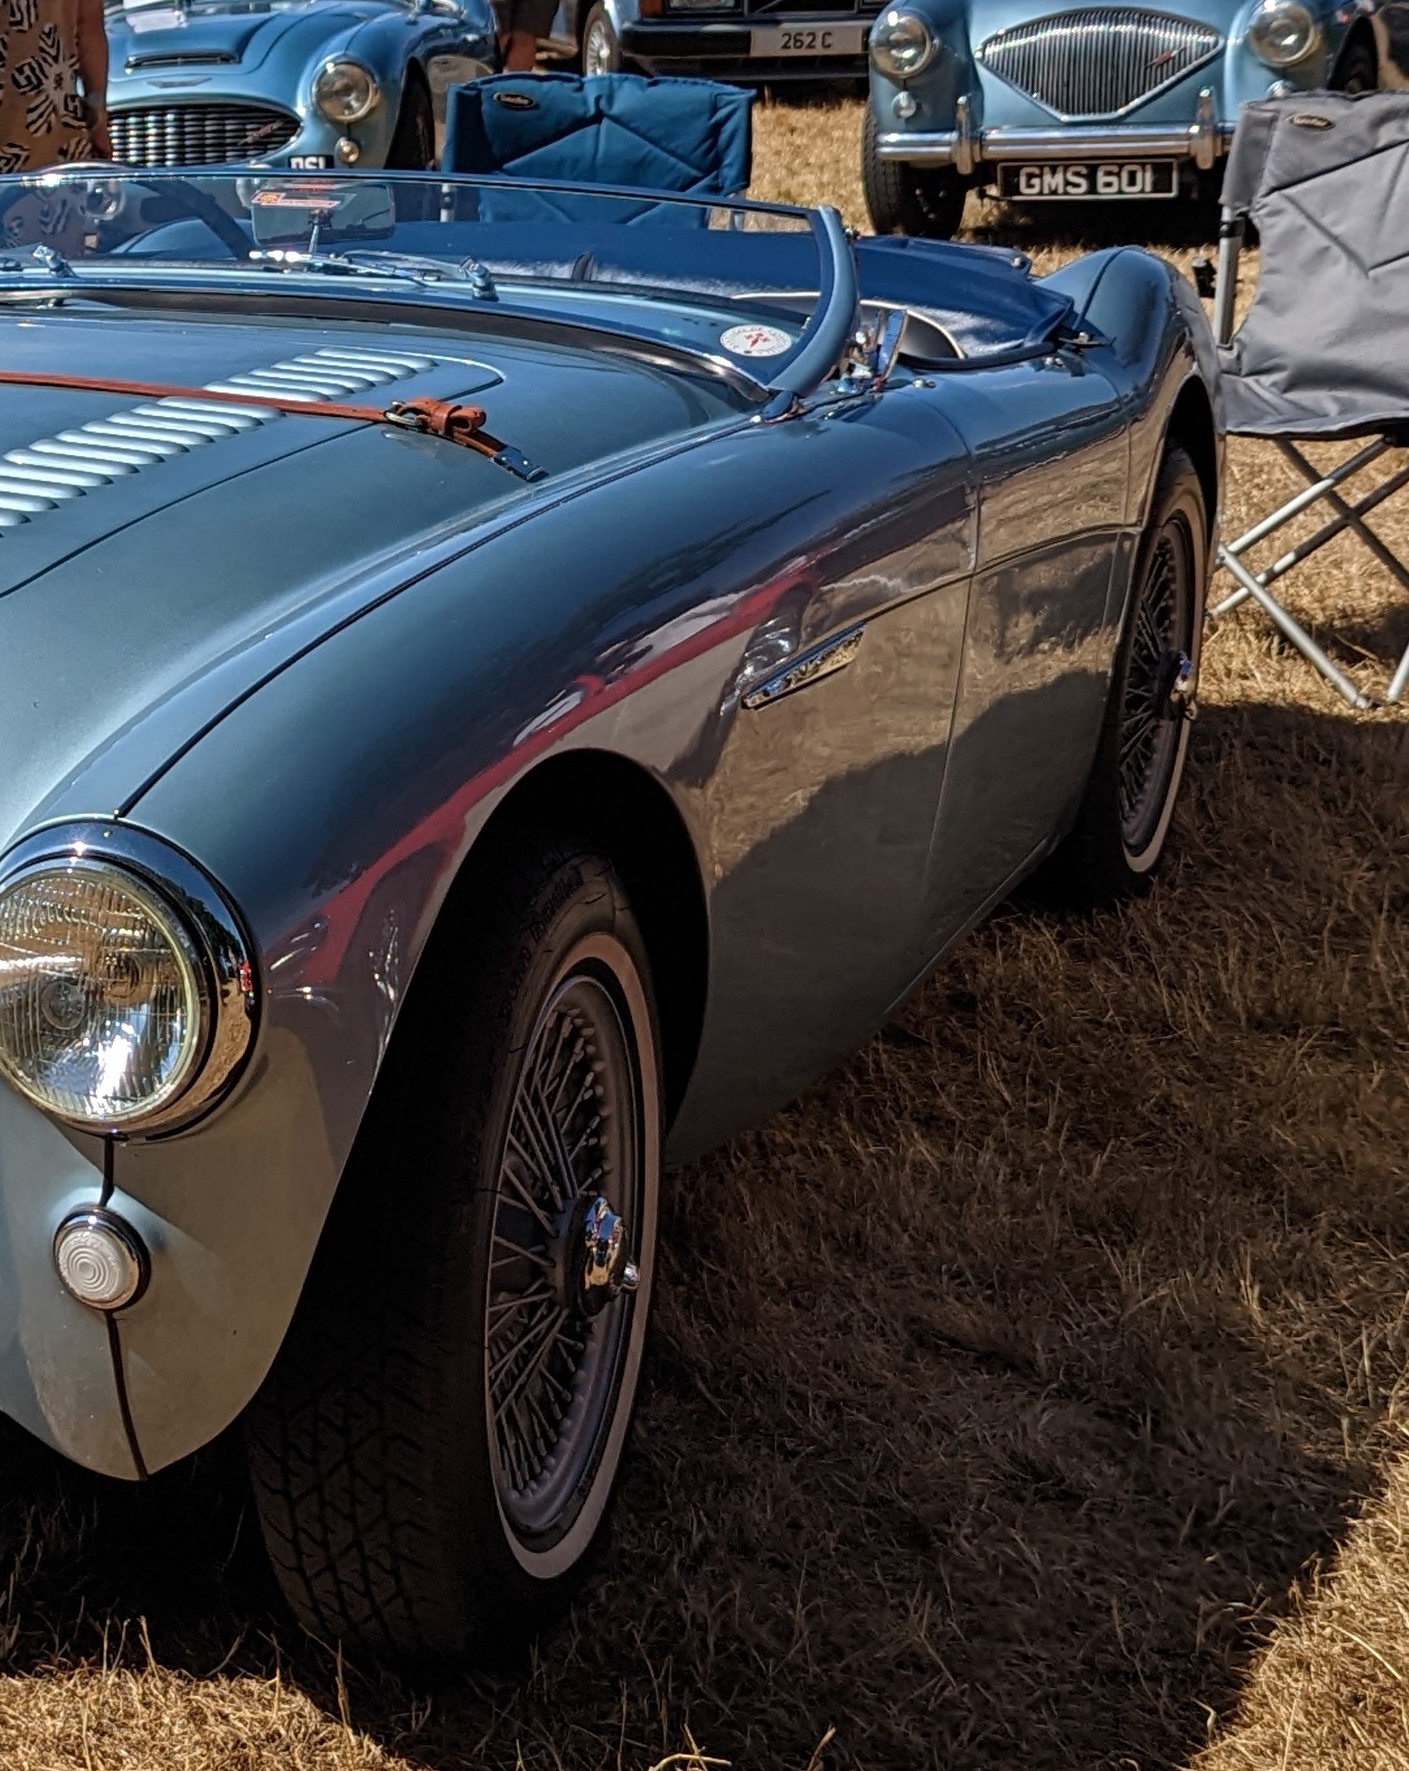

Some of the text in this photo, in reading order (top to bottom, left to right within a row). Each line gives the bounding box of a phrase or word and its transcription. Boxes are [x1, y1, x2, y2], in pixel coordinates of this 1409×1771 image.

[781, 31, 833, 49] 262 C
[1019, 163, 1154, 195] GMS 601
